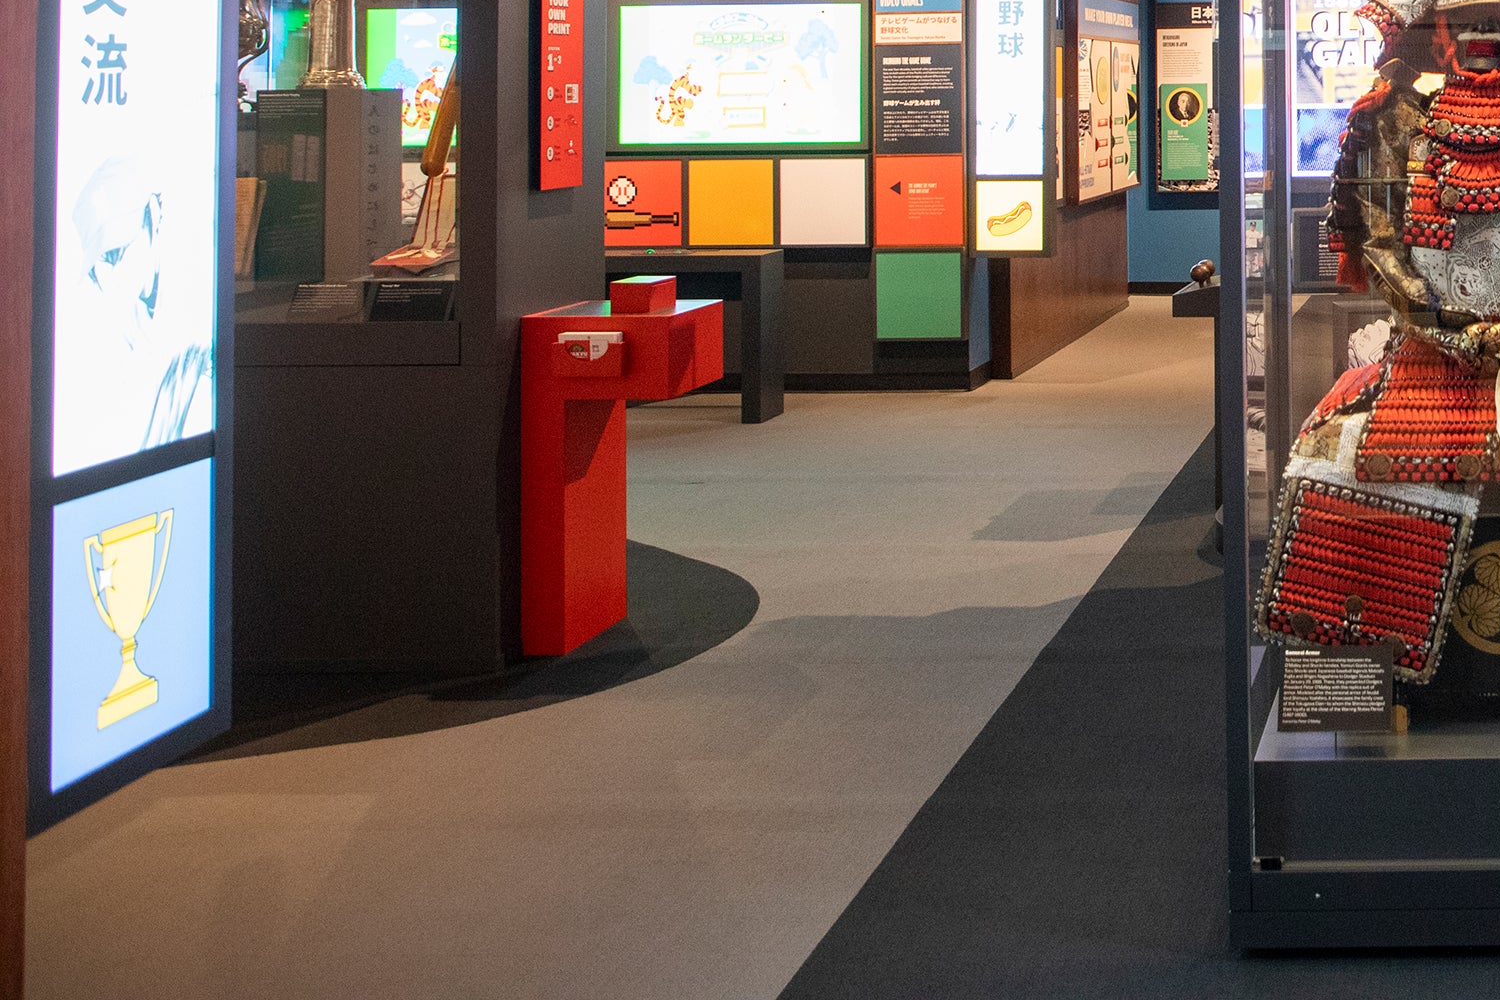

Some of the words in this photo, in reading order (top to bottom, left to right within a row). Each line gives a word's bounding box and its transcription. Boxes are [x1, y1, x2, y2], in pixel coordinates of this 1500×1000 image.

[548, 7, 566, 21] OWN
[548, 22, 571, 36] PRINT
[547, 53, 554, 71] 1
